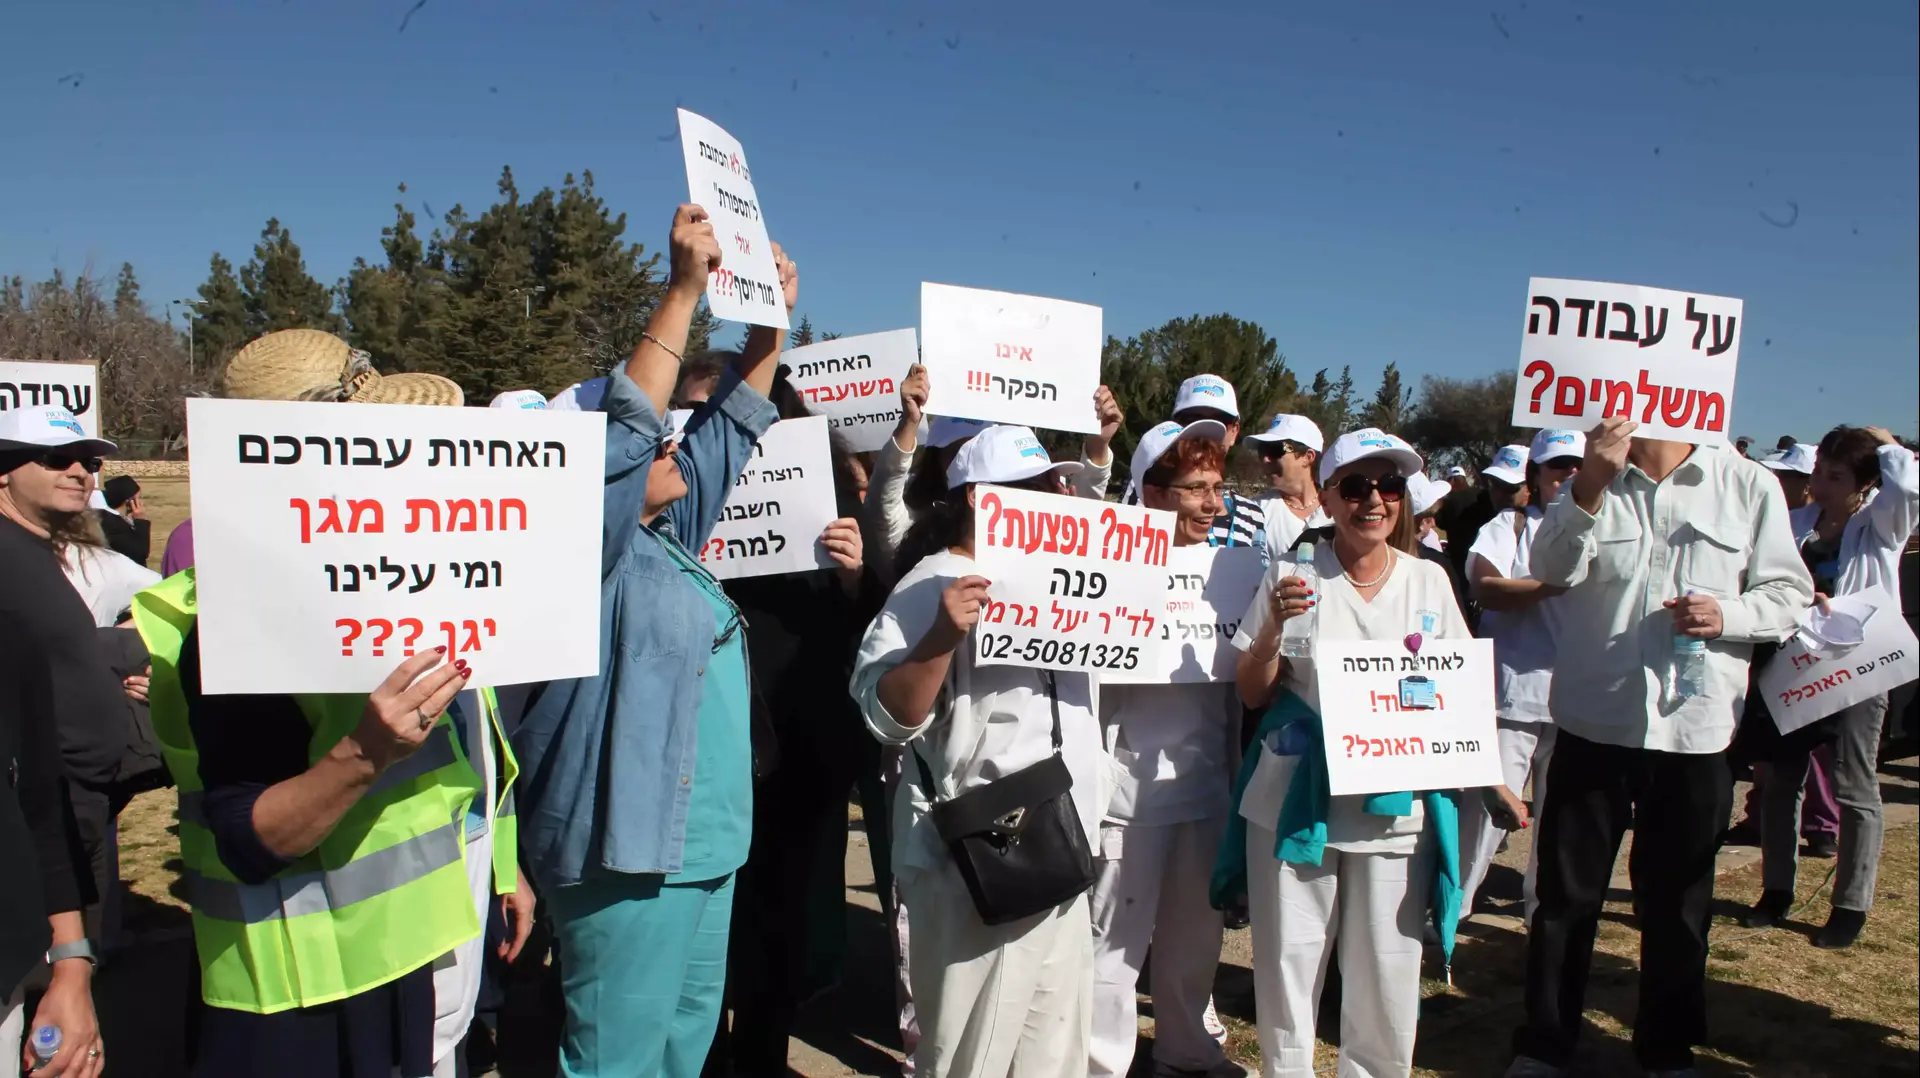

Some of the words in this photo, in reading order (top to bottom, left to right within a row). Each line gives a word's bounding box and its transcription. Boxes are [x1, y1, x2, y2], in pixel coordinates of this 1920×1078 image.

[699, 140, 729, 170] הכתובת
[729, 152, 741, 176] לא
[735, 231, 751, 255] אולי
[757, 282, 775, 306] מור
[1527, 295, 1670, 349] עבודה
[1685, 296, 1737, 357] על
[798, 354, 872, 378] האחיות
[994, 342, 1033, 361] אינו
[967, 370, 1057, 401] הפקר!!!
[1523, 359, 1726, 432] משלמים?
[239, 433, 412, 468] עבורכם
[428, 439, 567, 468] האחיות
[763, 467, 803, 483] רוצה
[290, 497, 384, 543] מגן
[404, 498, 528, 533] חומת
[981, 492, 1089, 557] נפצעת?
[1100, 508, 1168, 566] חלית?
[325, 556, 435, 594] עלינו
[450, 560, 502, 589] ומי
[1049, 567, 1107, 599] פנה
[1051, 600, 1089, 633] יעל
[1099, 607, 1155, 637] לד"ר
[335, 617, 424, 657] ???
[440, 618, 497, 661] יגן
[981, 633, 1140, 670] 02-5081325
[1343, 656, 1395, 673] הדסה
[1400, 652, 1464, 672] לאחית
[1855, 660, 1876, 676] עם
[1878, 648, 1905, 667] ומה
[1778, 668, 1852, 708] האוכל?
[1342, 735, 1425, 758] האוכל?
[1432, 741, 1451, 755] עם
[1456, 740, 1480, 754] ומה
